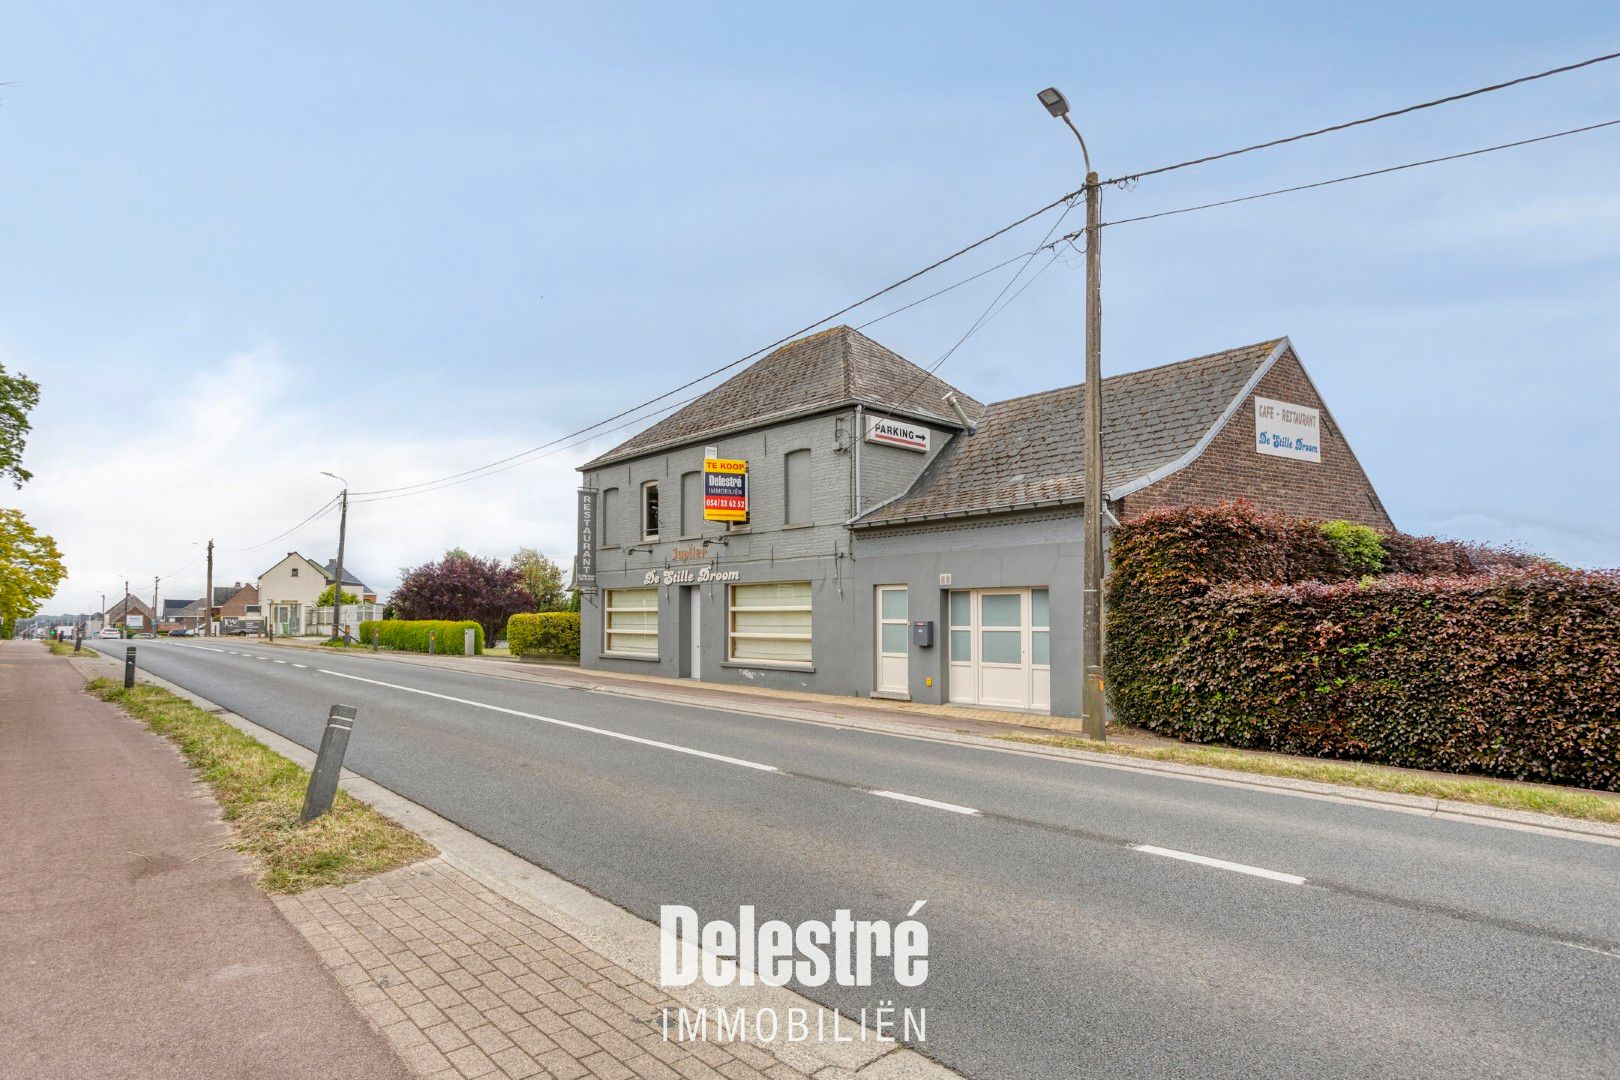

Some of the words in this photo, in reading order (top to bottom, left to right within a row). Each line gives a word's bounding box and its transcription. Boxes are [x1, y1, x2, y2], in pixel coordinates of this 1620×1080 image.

[1259, 404, 1274, 420] CAFE
[1282, 409, 1317, 428] RESTAURANT
[875, 424, 914, 440] PARKING
[1259, 431, 1271, 445] De
[1272, 434, 1293, 449] Stille
[1295, 438, 1318, 454] Droom
[706, 461, 718, 469] TE
[720, 462, 745, 471] KOOP
[708, 474, 742, 488] Delestré
[706, 498, 728, 508] 054/33
[729, 499, 737, 509] 62
[737, 500, 745, 509] 52
[583, 495, 591, 574] RESTAURANT
[643, 570, 660, 585] De
[663, 569, 695, 586] Stille
[697, 566, 740, 583] Droom
